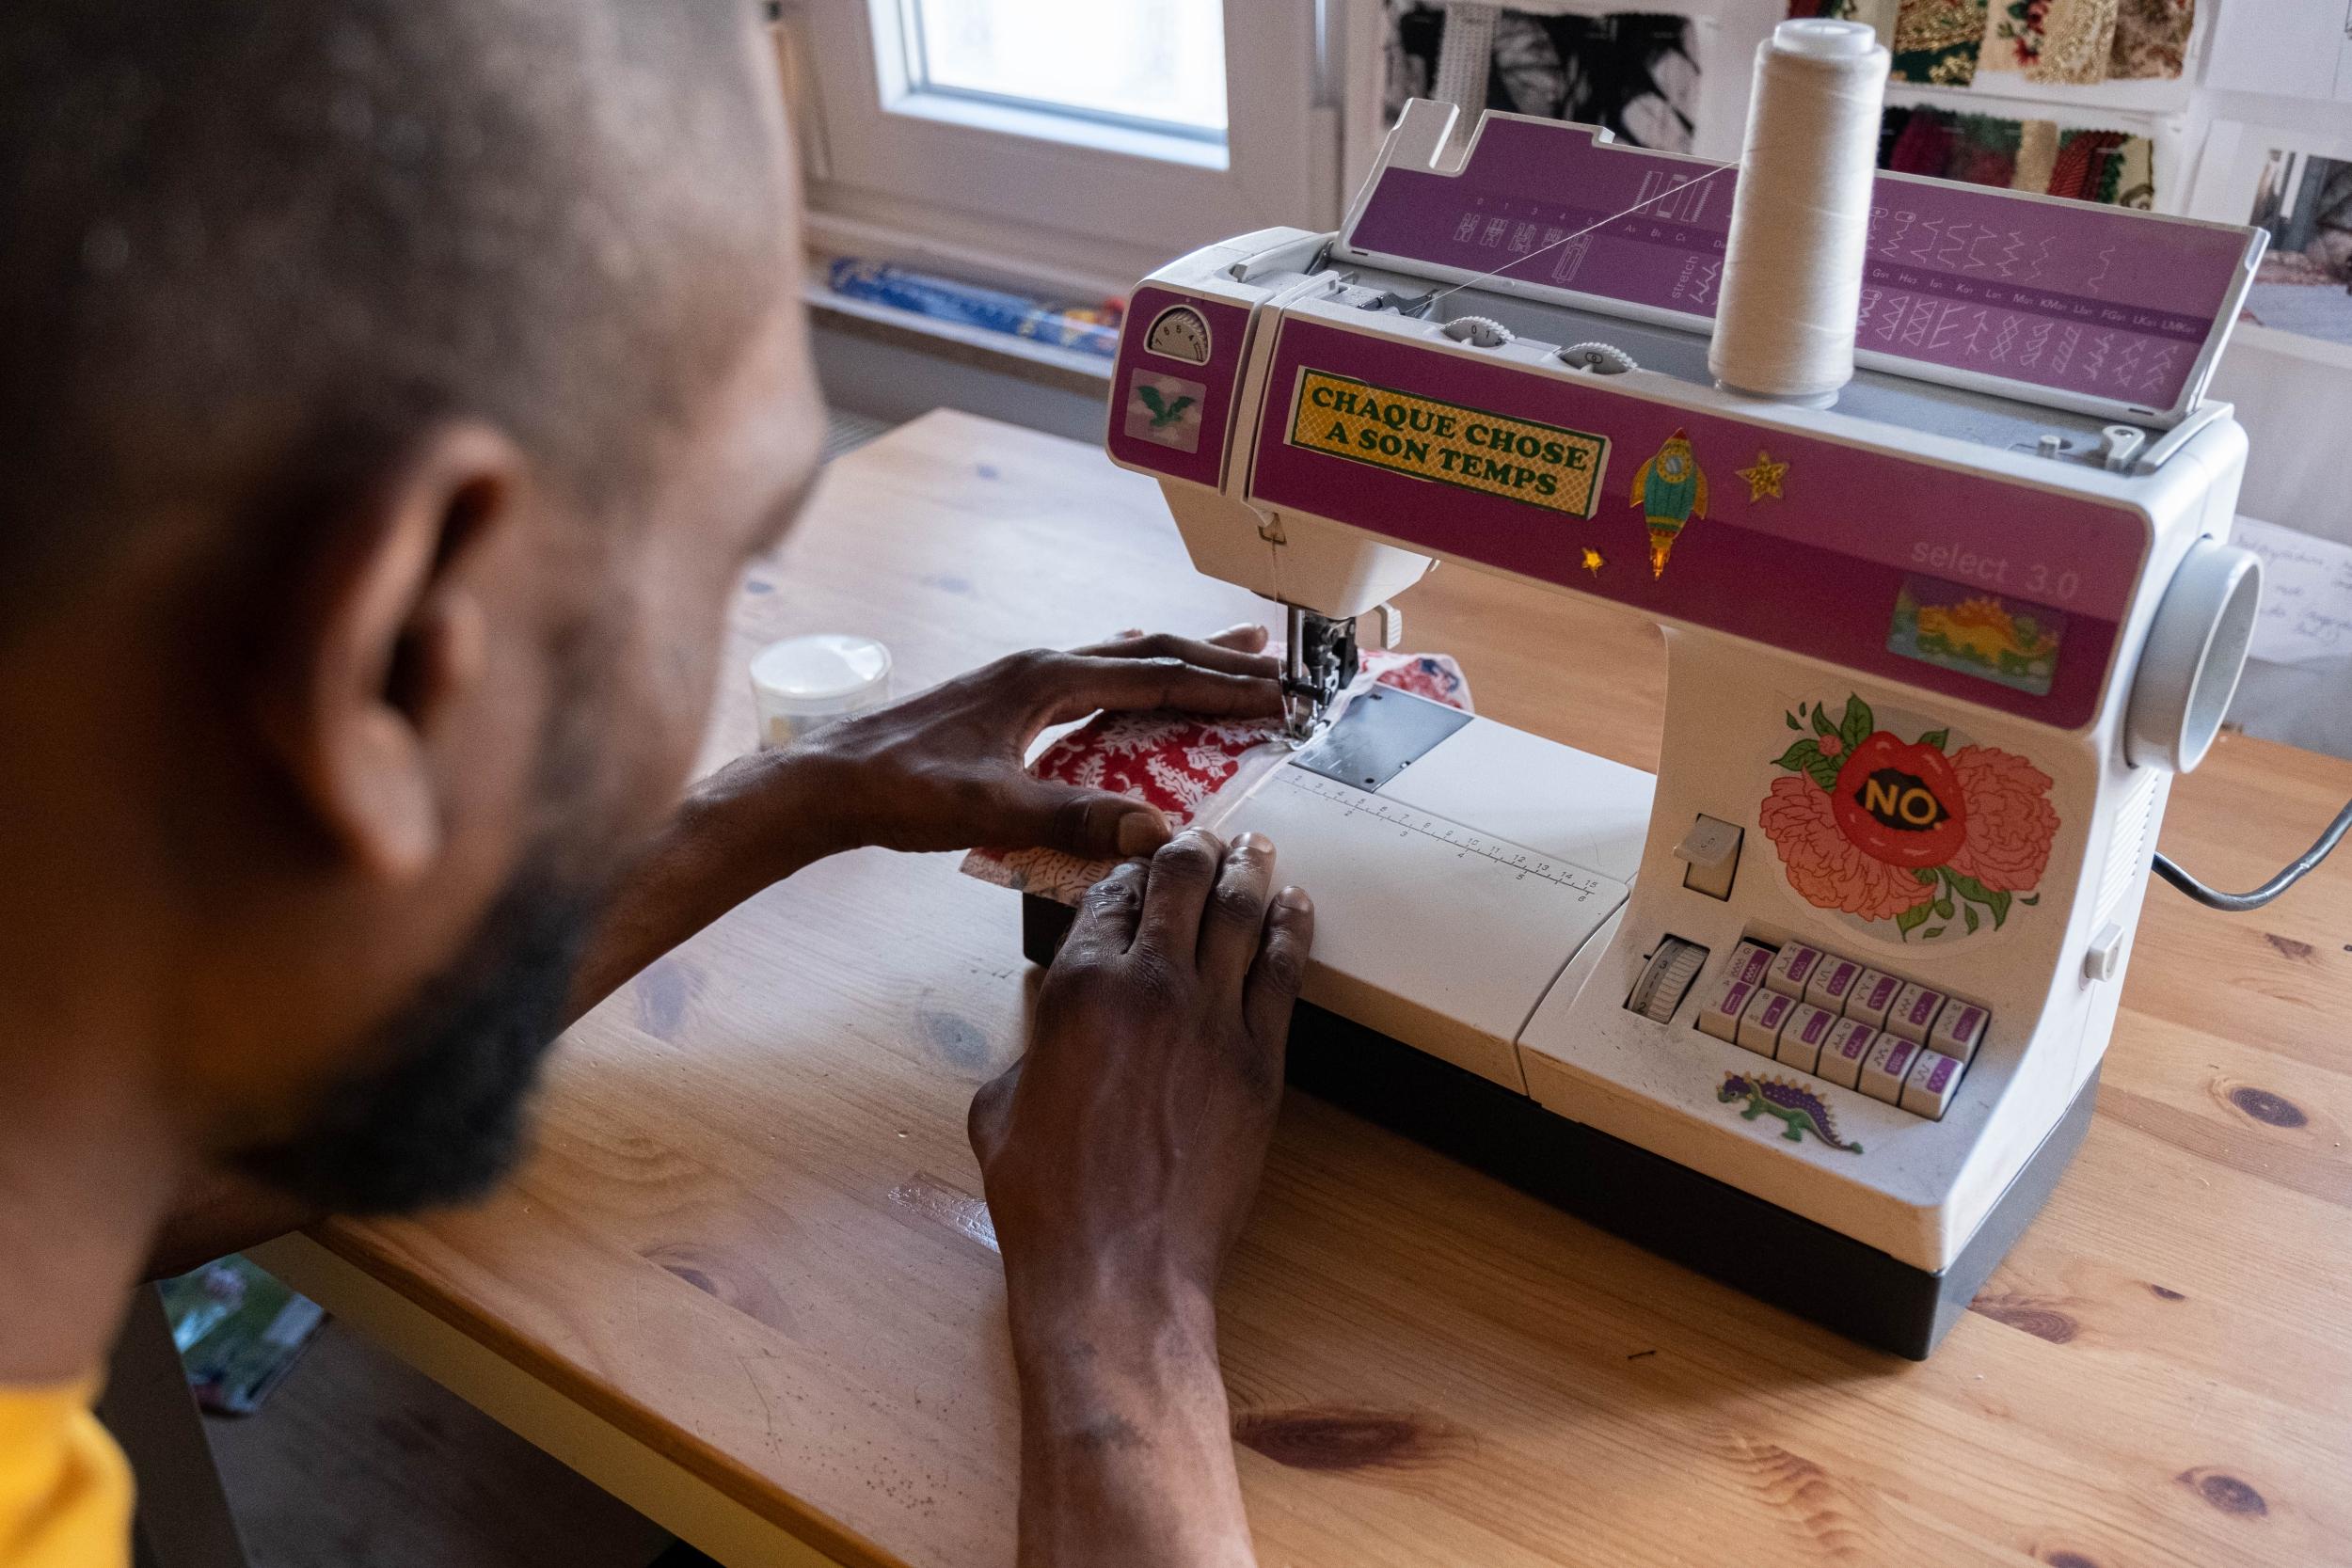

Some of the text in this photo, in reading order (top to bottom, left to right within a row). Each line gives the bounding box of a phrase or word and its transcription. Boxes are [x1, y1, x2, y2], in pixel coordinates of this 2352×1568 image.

[1672, 255, 1699, 299] stretch
[1470, 325, 1491, 339] 0 1
[1311, 387, 1588, 471] CHAQUE CHOSE
[1326, 421, 1558, 496] A SON TEMPS
[1911, 542, 2079, 601] select 3.0
[1513, 854, 1526, 863] 12
[1536, 863, 1550, 871] 13
[1562, 871, 1574, 879] 14
[1585, 879, 1598, 888] 15
[1637, 959, 1668, 1014] 3 2
